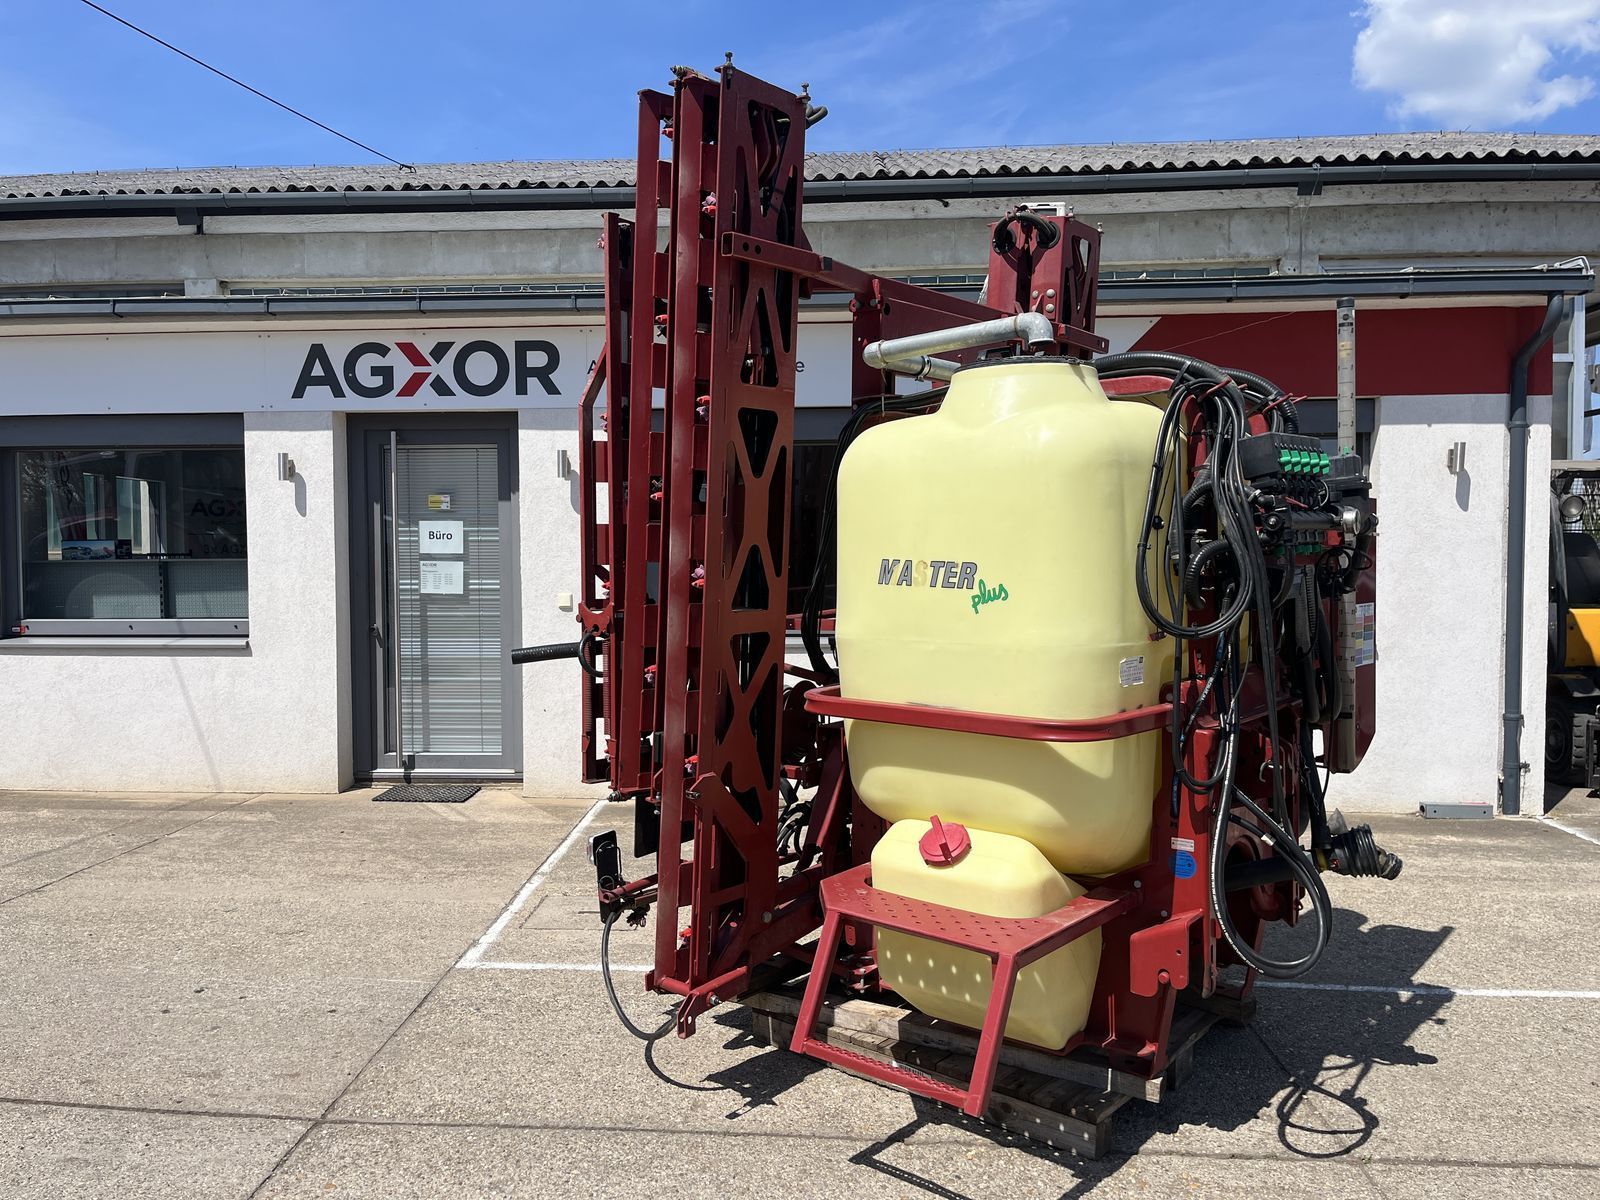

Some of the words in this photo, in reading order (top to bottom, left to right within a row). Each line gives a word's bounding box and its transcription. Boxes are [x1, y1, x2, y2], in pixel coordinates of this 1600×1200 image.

[291, 340, 562, 399] AGXOR
[191, 499, 243, 517] AGX
[428, 531, 453, 540] Büro
[220, 544, 243, 554] AG
[971, 578, 1009, 614] plus
